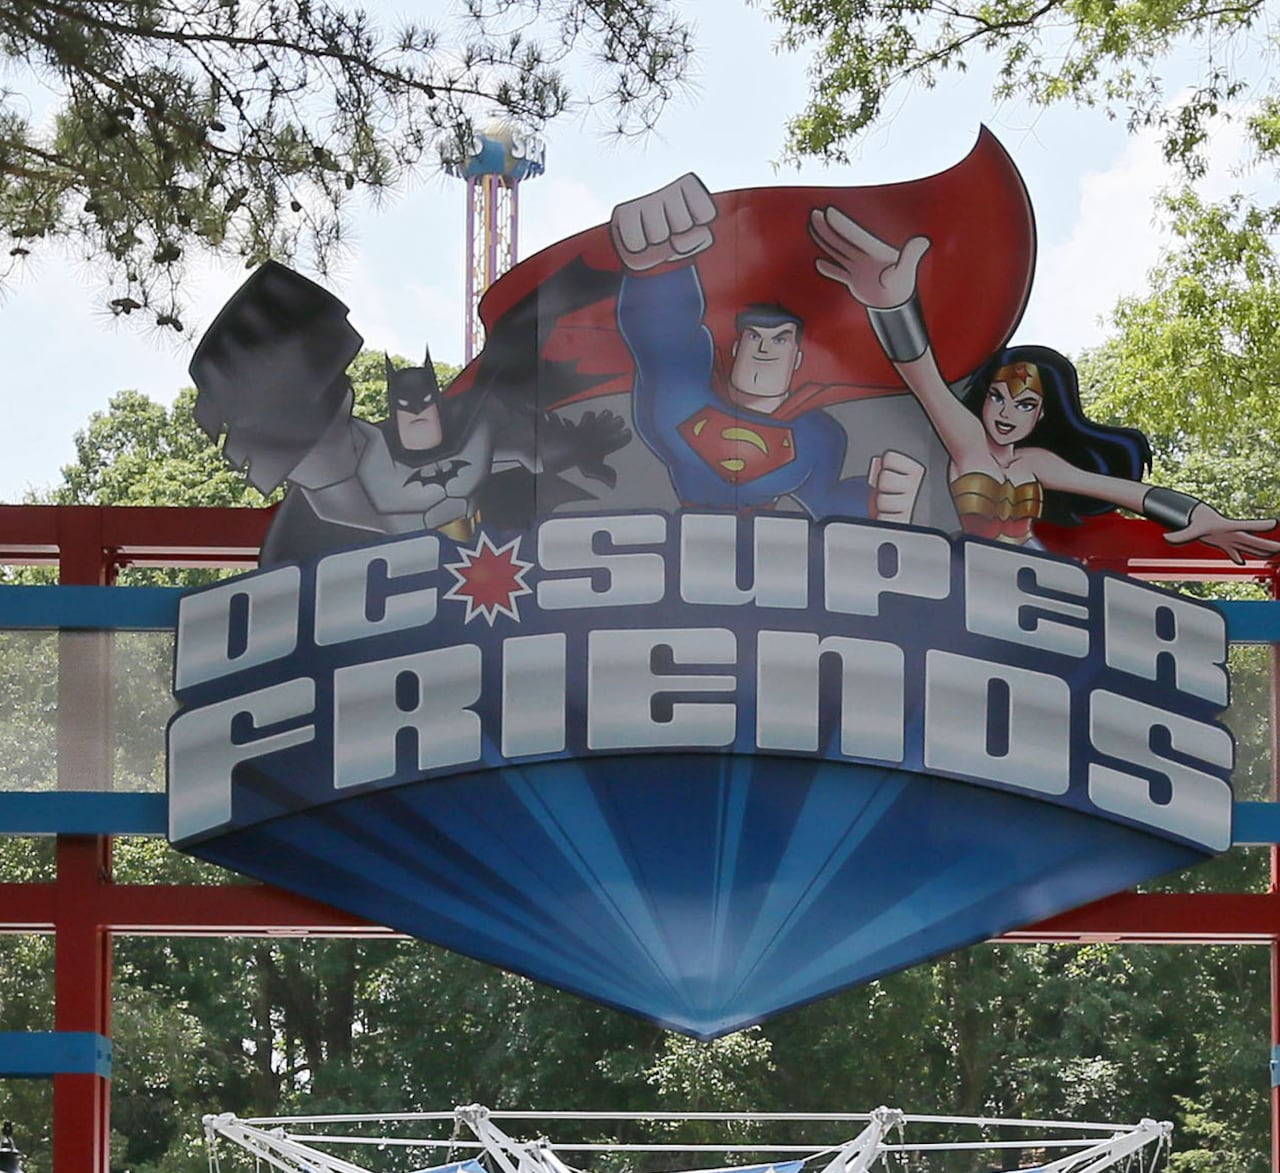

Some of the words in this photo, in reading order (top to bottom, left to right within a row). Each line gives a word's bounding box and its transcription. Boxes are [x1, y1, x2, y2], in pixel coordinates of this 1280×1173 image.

[174, 534, 443, 697] DC
[536, 513, 1232, 707] SUPER
[167, 627, 1234, 853] FRIENDS
